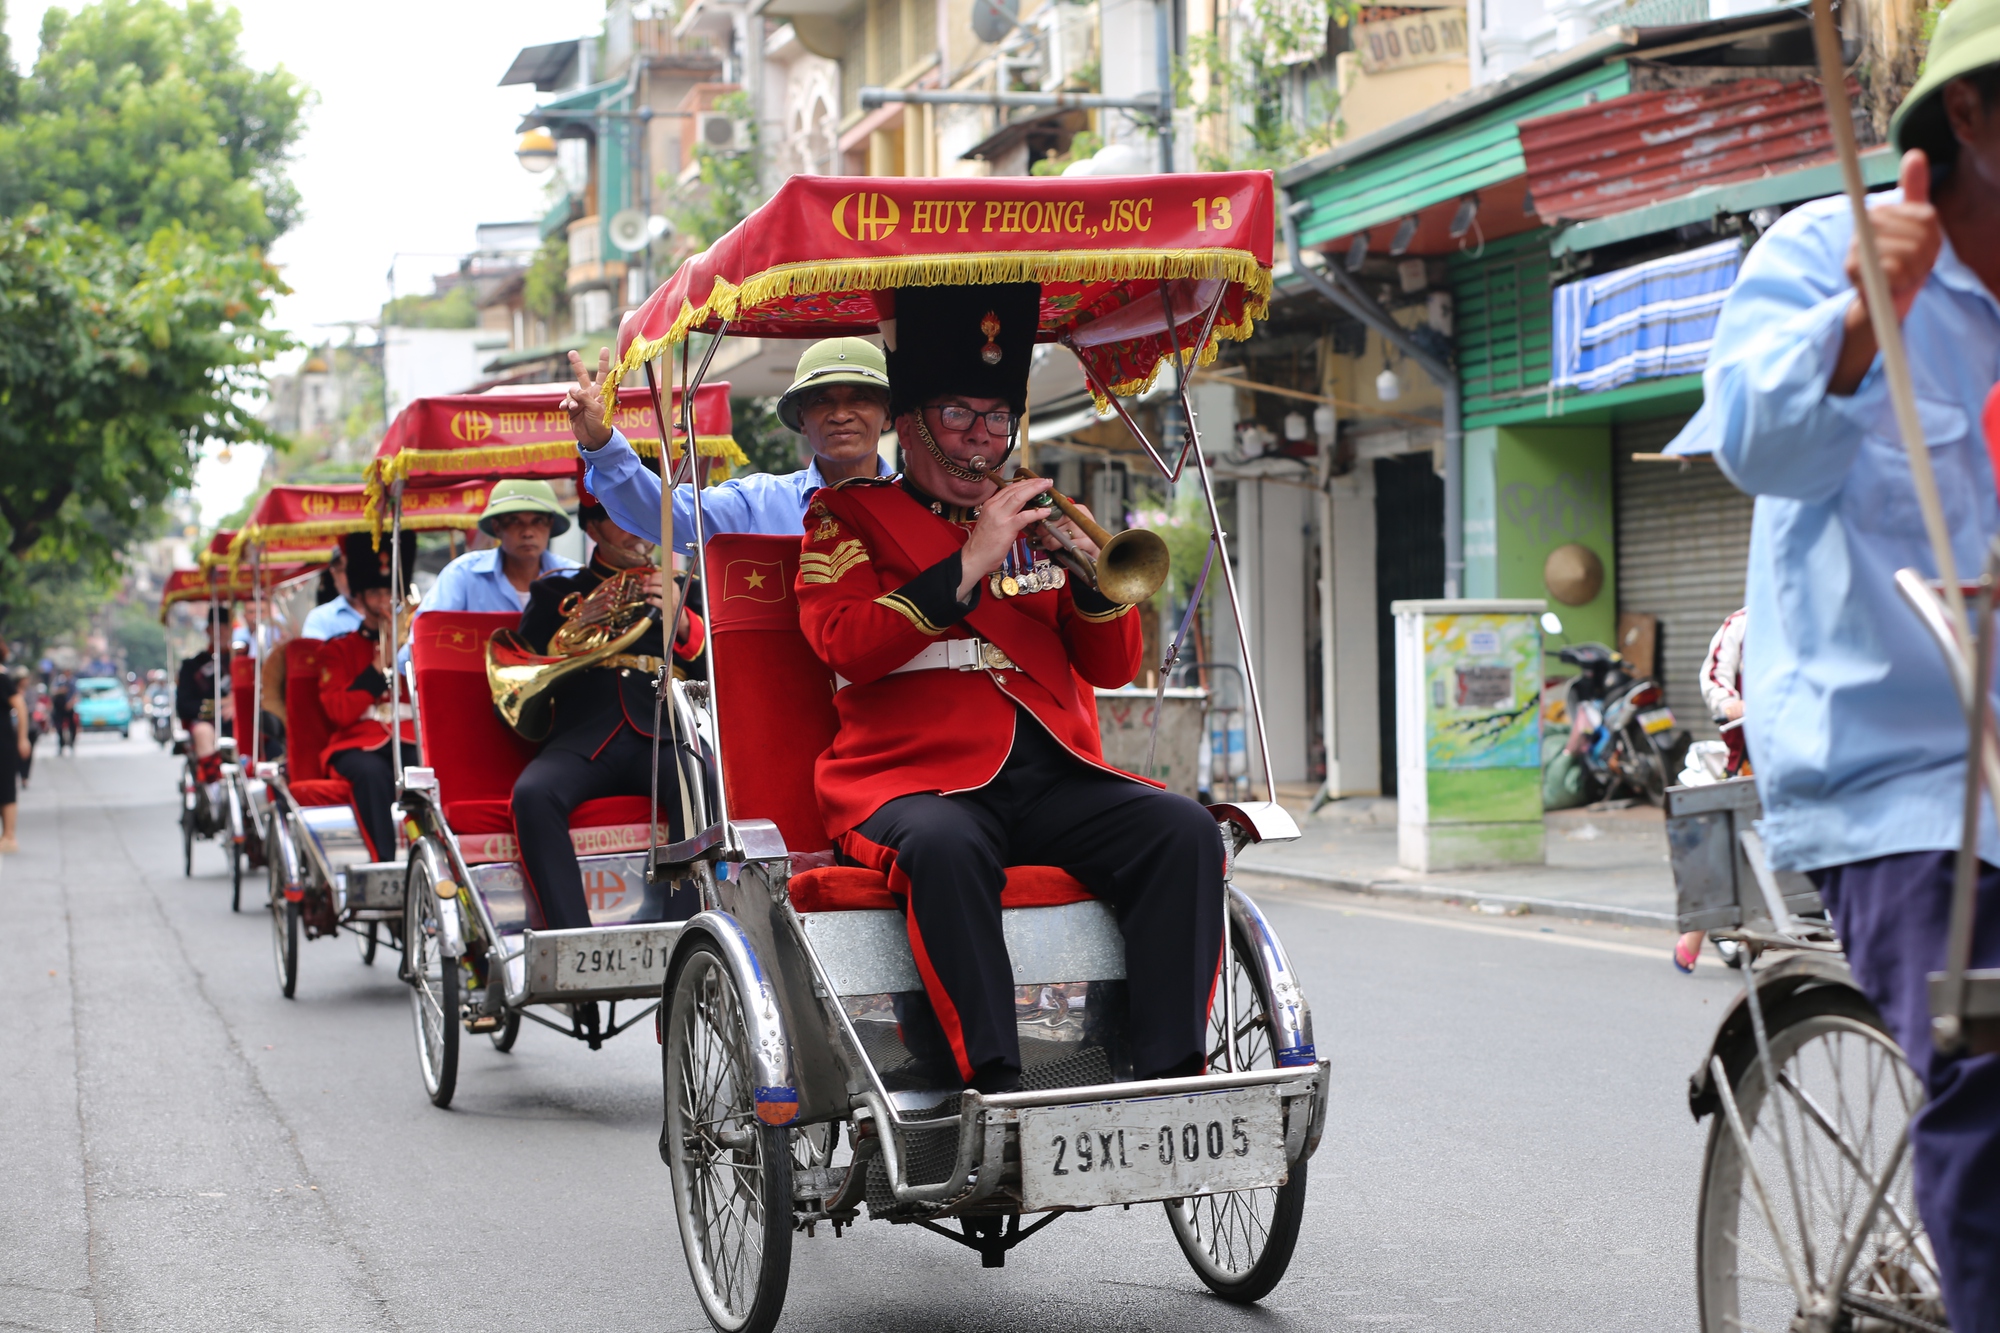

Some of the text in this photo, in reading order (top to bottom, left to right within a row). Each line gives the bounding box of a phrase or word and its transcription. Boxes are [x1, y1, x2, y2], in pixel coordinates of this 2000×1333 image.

[911, 200, 977, 234] HUY
[1191, 196, 1233, 232] 13
[498, 412, 539, 434] HUY
[576, 946, 668, 973] 29XL-01
[1051, 1115, 1250, 1175] 29XL-0005
